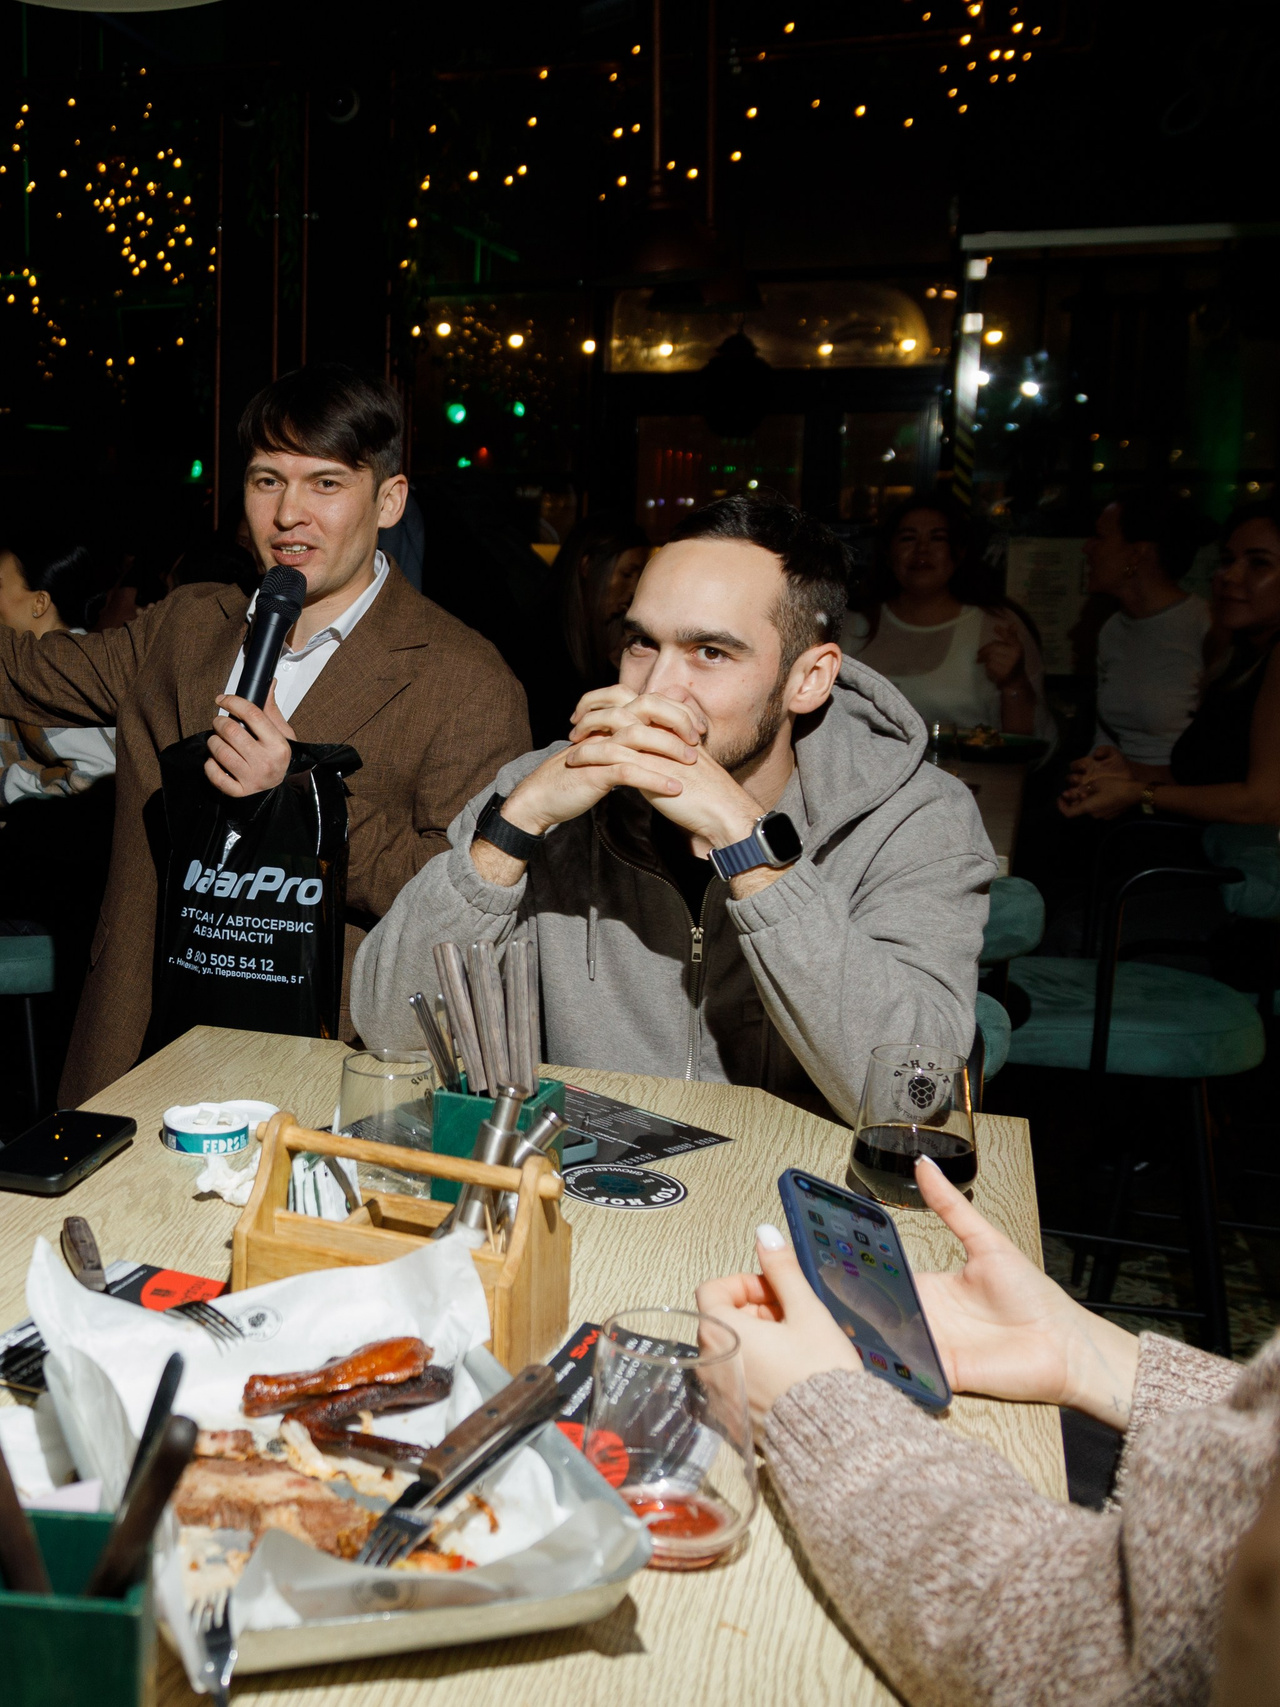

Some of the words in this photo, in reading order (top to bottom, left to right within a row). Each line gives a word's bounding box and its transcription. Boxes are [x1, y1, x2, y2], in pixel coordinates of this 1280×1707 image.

[225, 915, 315, 934] АВТОСЕРВИС
[210, 953, 235, 968] 505
[239, 956, 257, 970] 54
[260, 958, 274, 972] 12
[290, 975, 297, 984] 5
[202, 1136, 240, 1154] FEDRS
[596, 1166, 644, 1176] GROWLER
[593, 1196, 646, 1206] HOP
[650, 1187, 677, 1203] TOP
